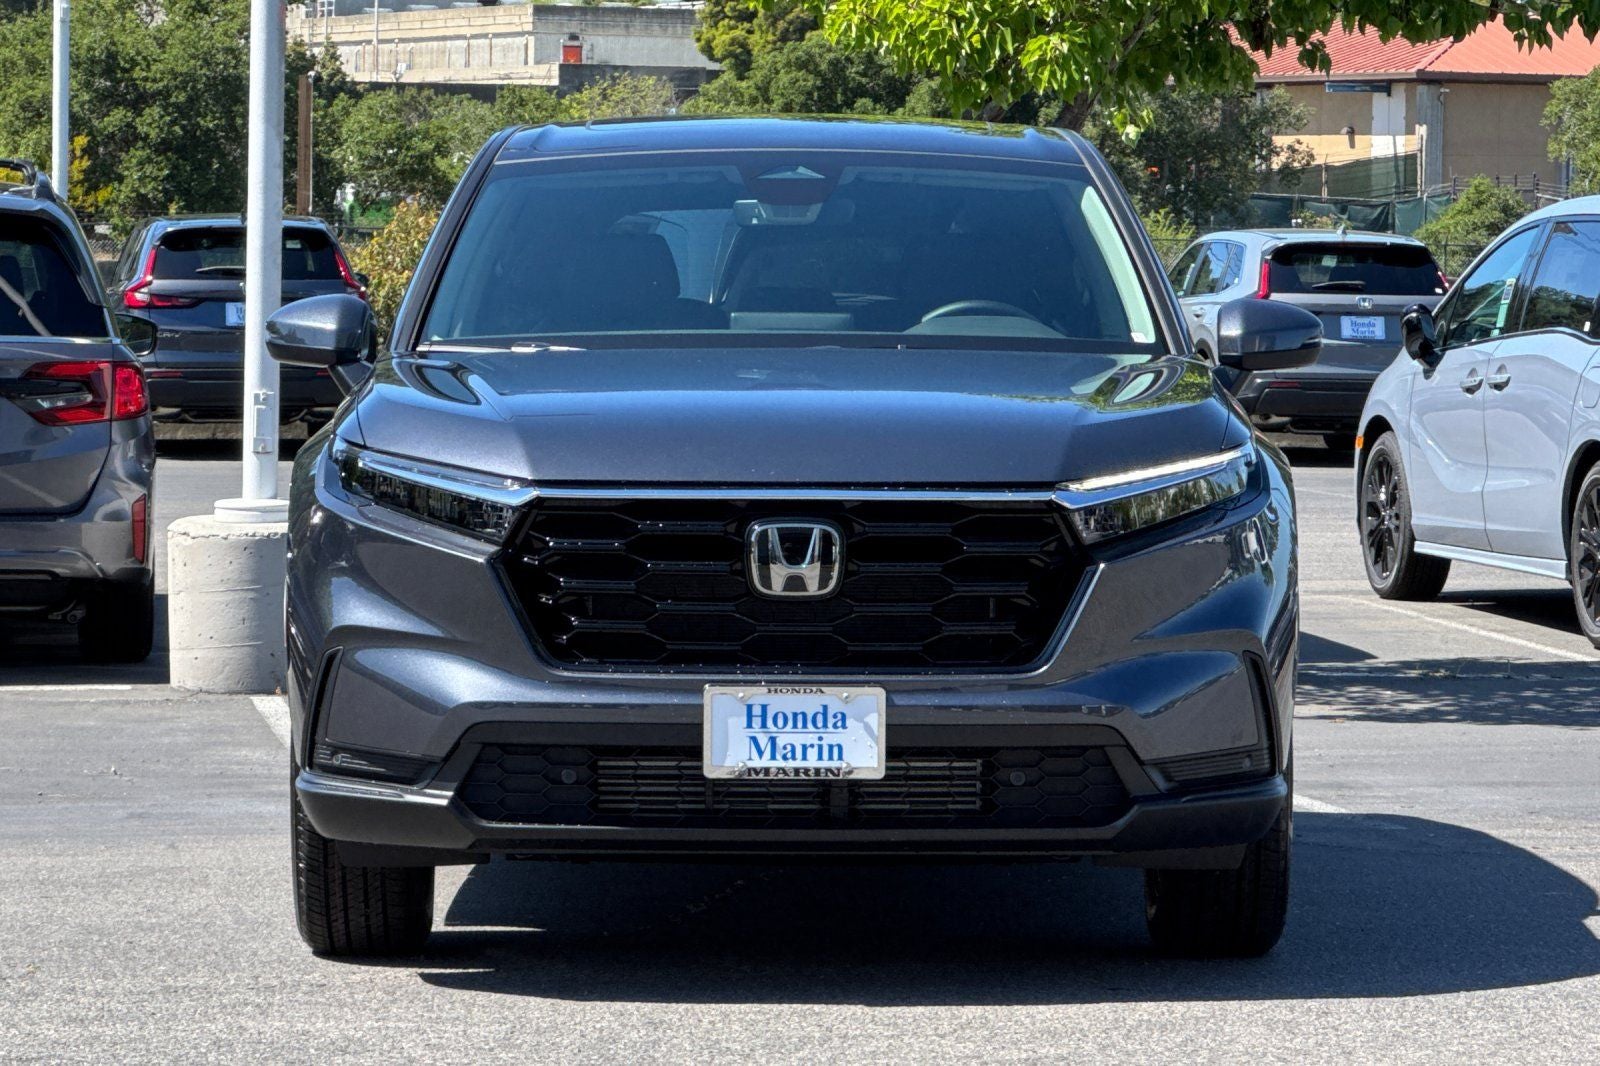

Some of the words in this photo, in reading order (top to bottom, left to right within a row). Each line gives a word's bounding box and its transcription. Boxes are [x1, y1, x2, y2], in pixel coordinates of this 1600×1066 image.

[1350, 320, 1376, 328] Honda
[743, 703, 848, 730] Honda
[746, 735, 845, 761] Marin
[746, 766, 842, 778] MARIN
